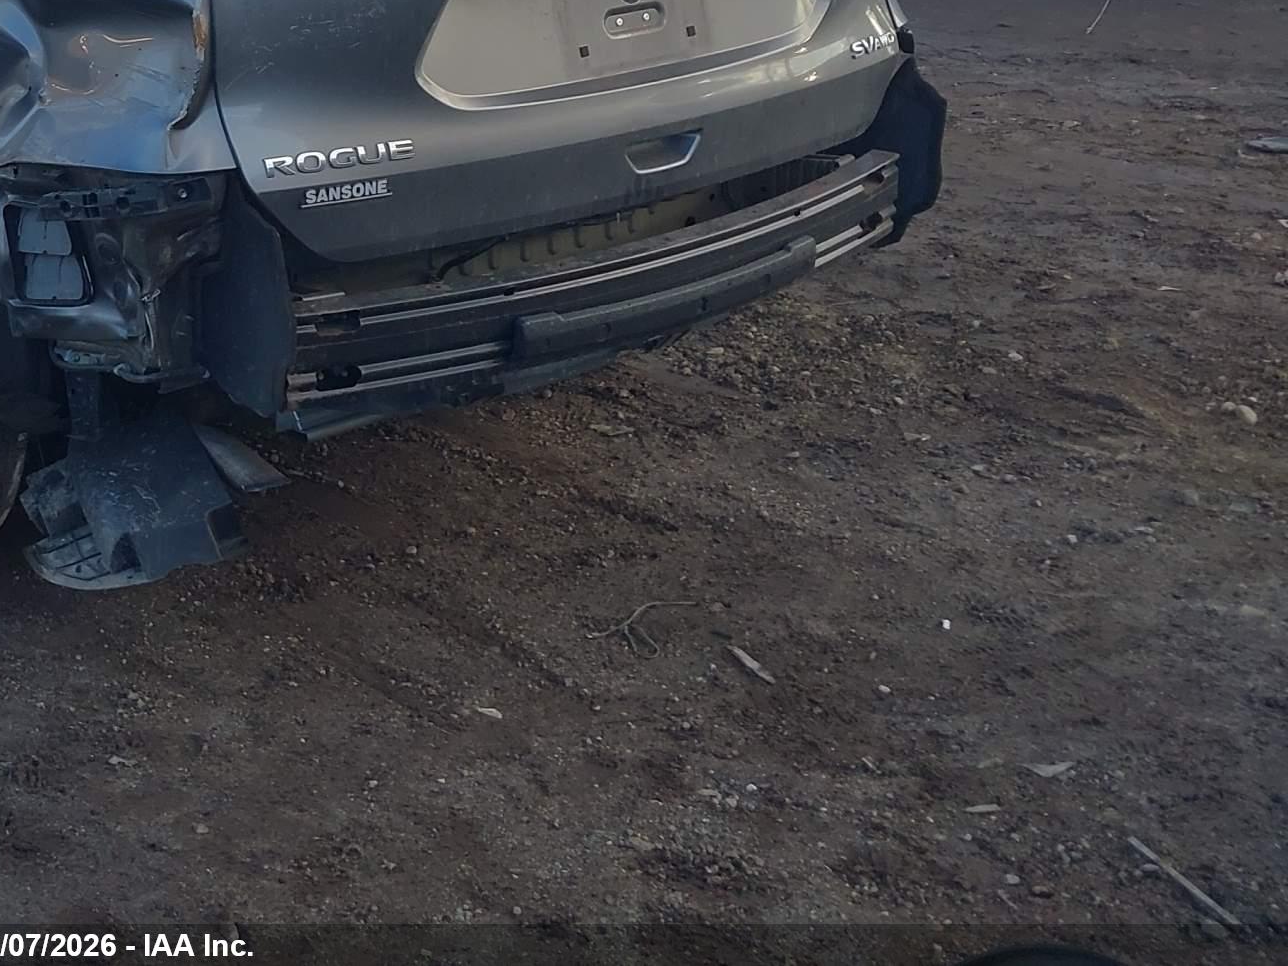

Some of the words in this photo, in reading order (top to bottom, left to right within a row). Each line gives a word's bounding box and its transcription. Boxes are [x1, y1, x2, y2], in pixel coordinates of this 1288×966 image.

[851, 36, 874, 55] SV
[263, 139, 415, 178] ROGUE
[305, 178, 388, 204] SANSONE
